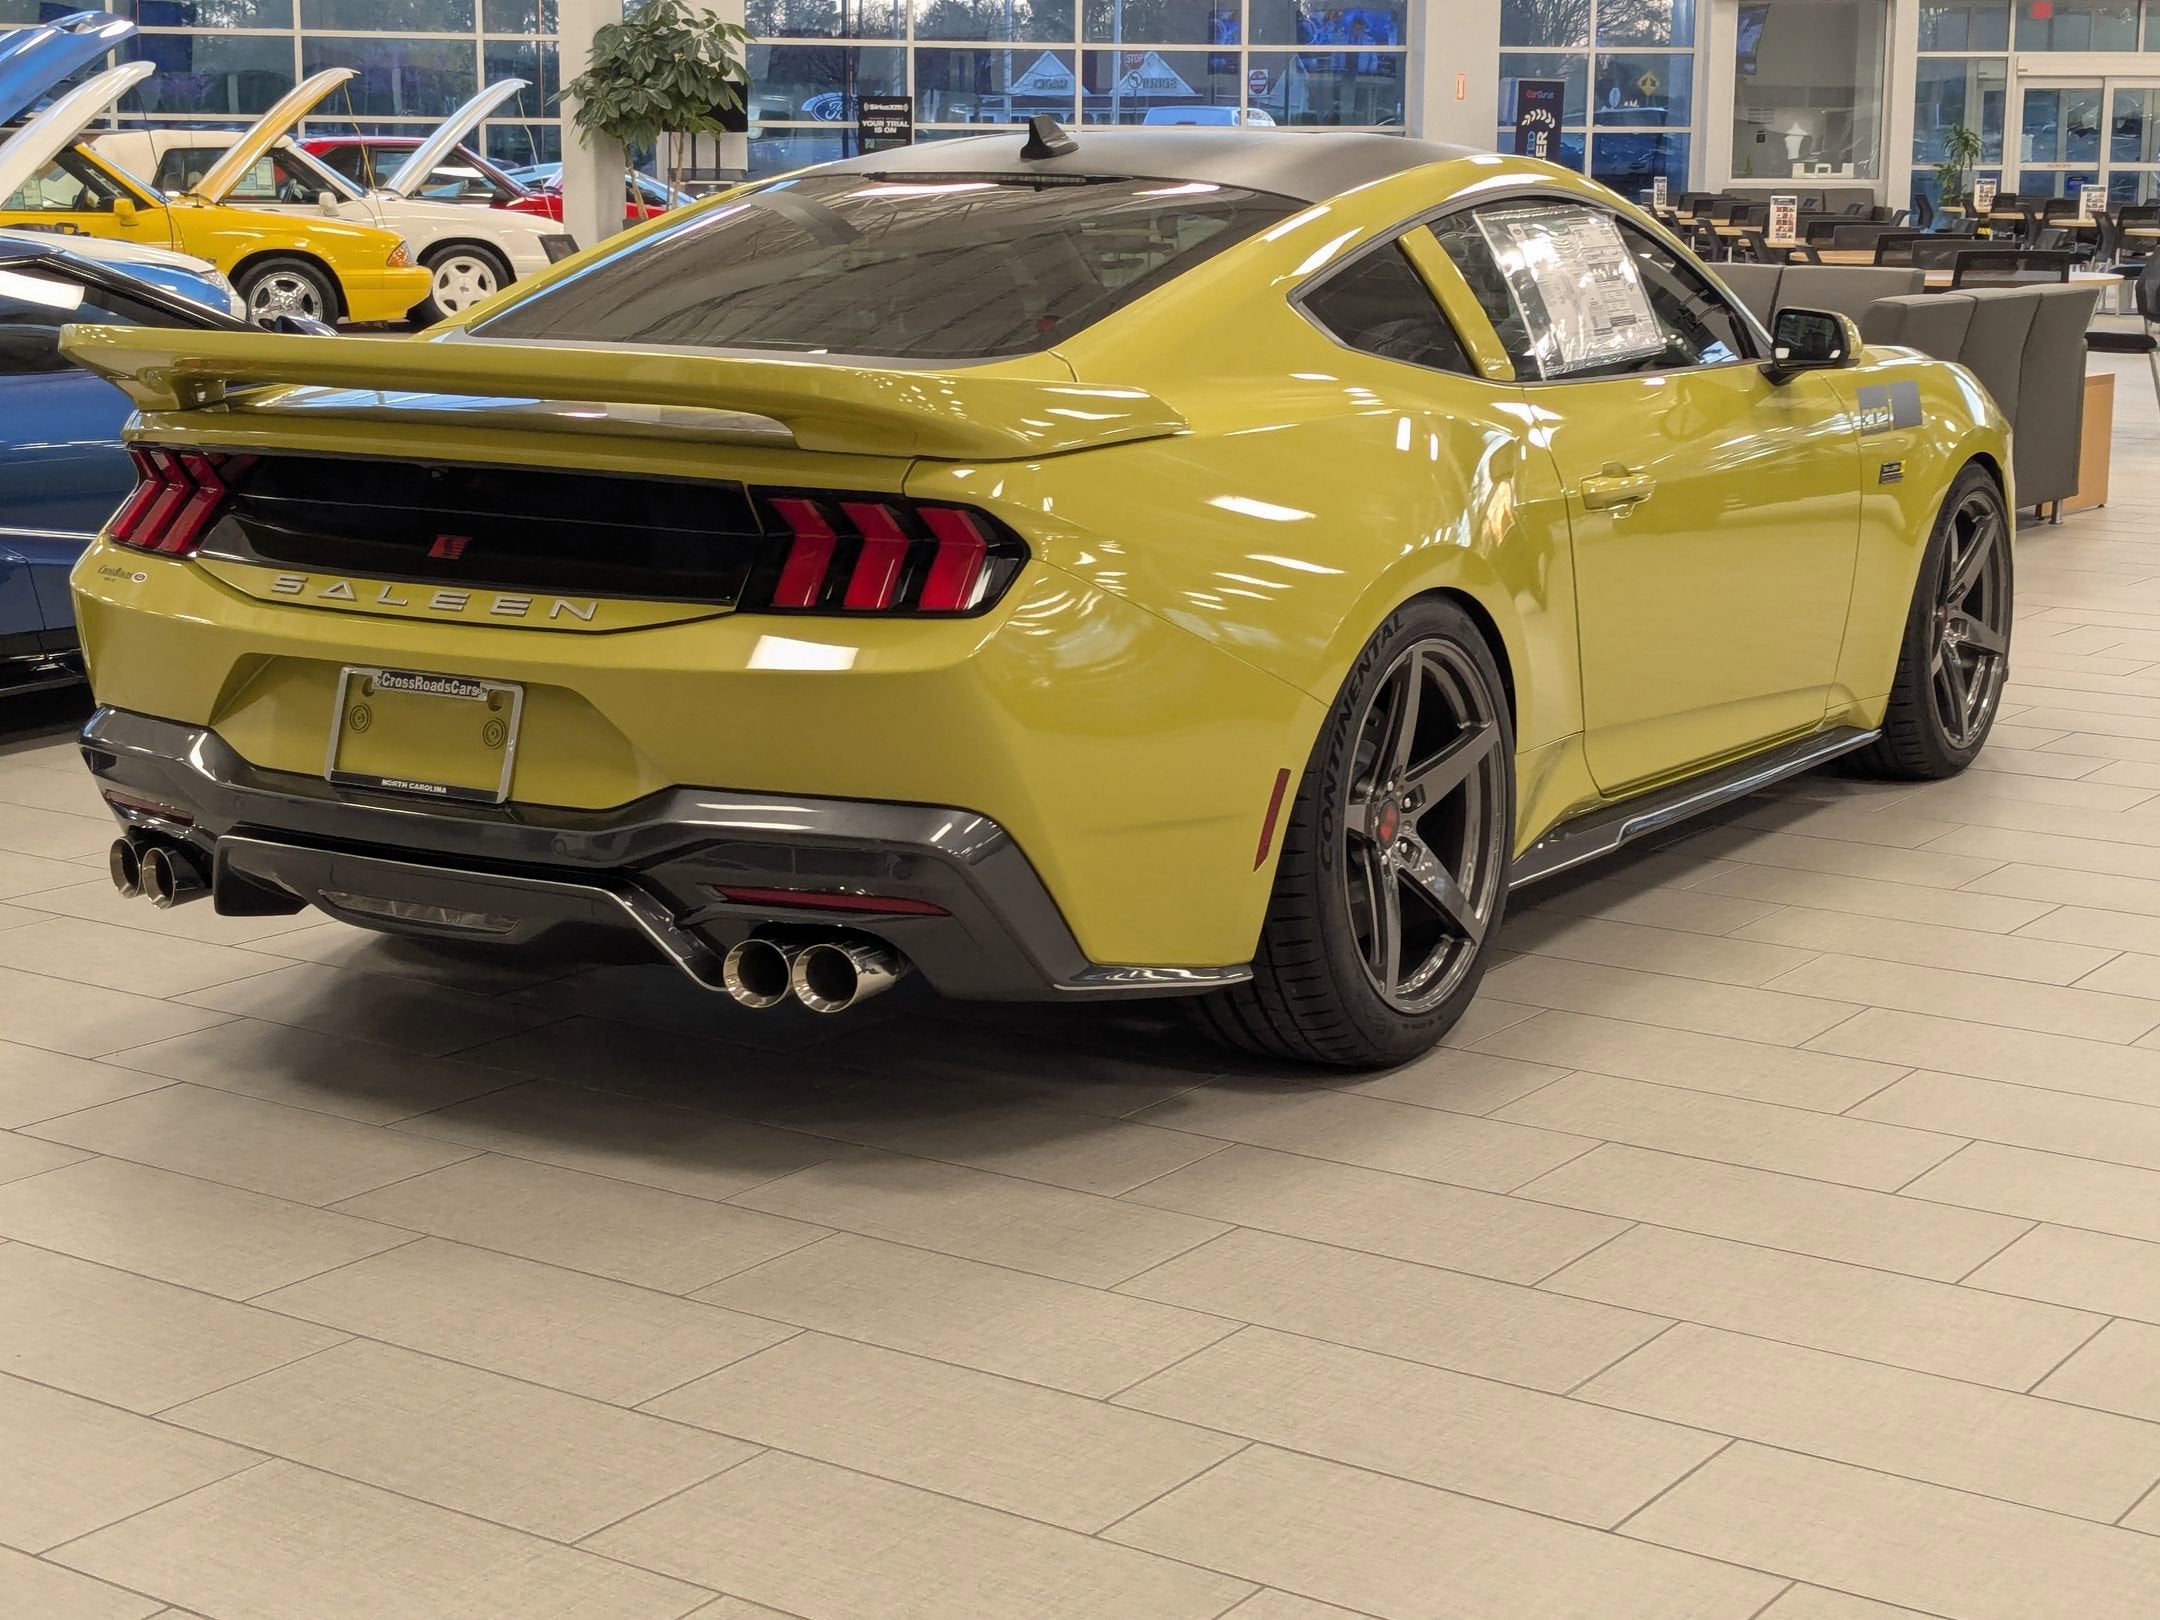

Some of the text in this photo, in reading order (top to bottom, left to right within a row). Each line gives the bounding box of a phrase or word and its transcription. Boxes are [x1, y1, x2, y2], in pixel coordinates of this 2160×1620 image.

[1126, 53, 1144, 63] STOP
[270, 574, 599, 622] SALEEN
[381, 673, 482, 698] CrossRoadsCars
[1320, 614, 1404, 873] CONTINENTAL
[381, 778, 448, 795] NORTH CAROLINA
